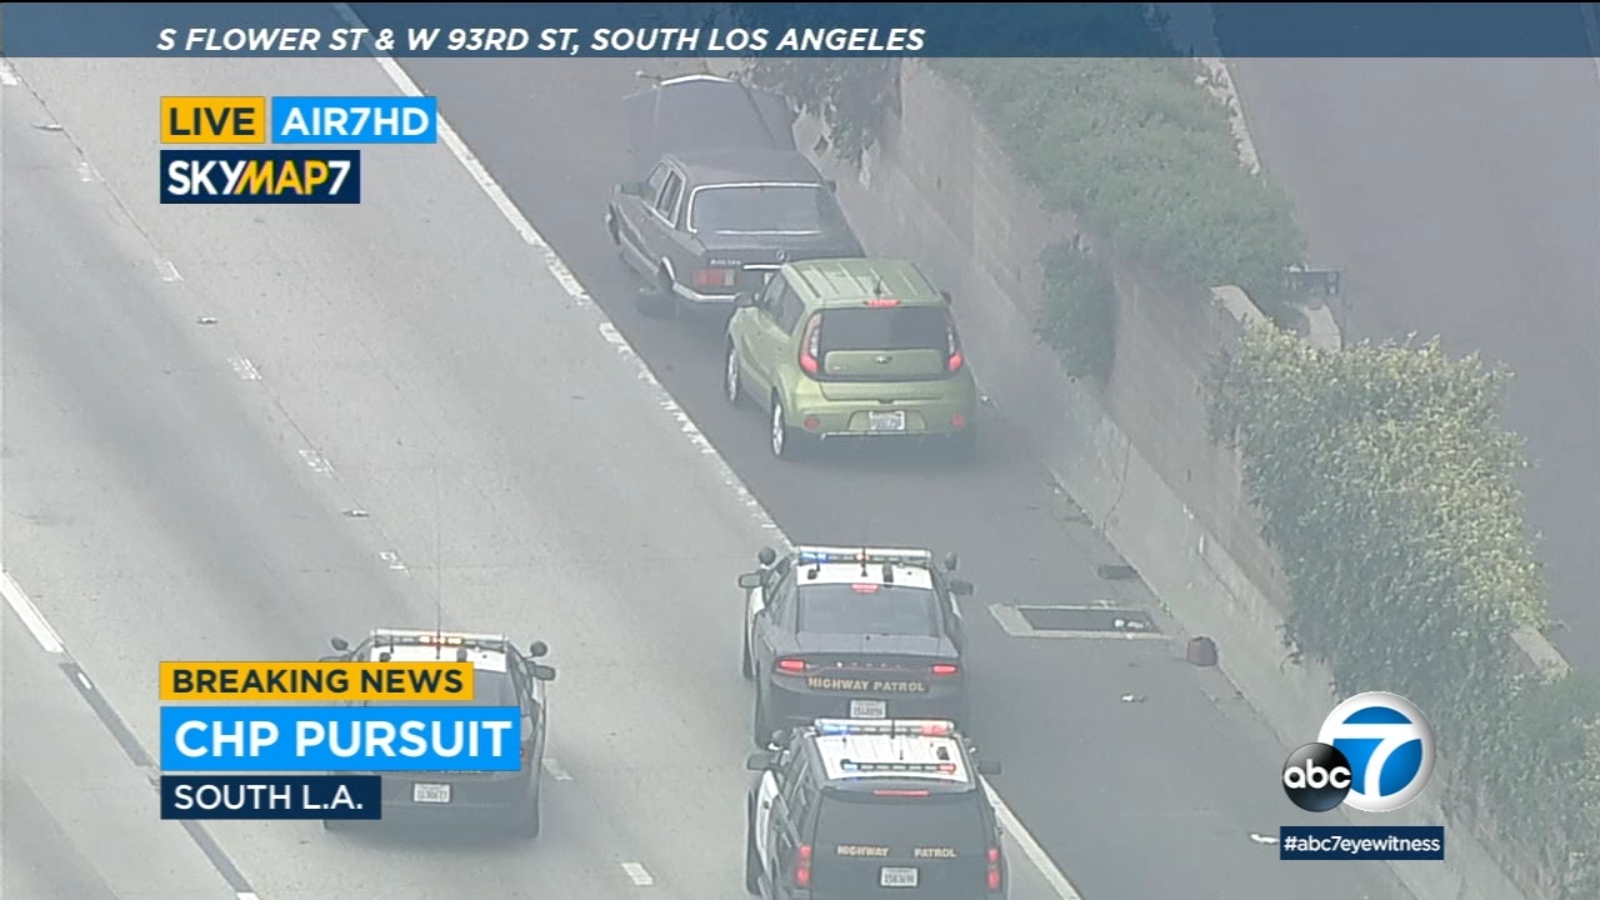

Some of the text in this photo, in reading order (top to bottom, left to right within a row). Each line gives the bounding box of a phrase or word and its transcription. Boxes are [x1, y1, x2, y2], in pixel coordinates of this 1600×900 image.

[808, 678, 926, 692] HIGHWAY PATROL
[837, 845, 957, 858] HIGHWAY PATROL
